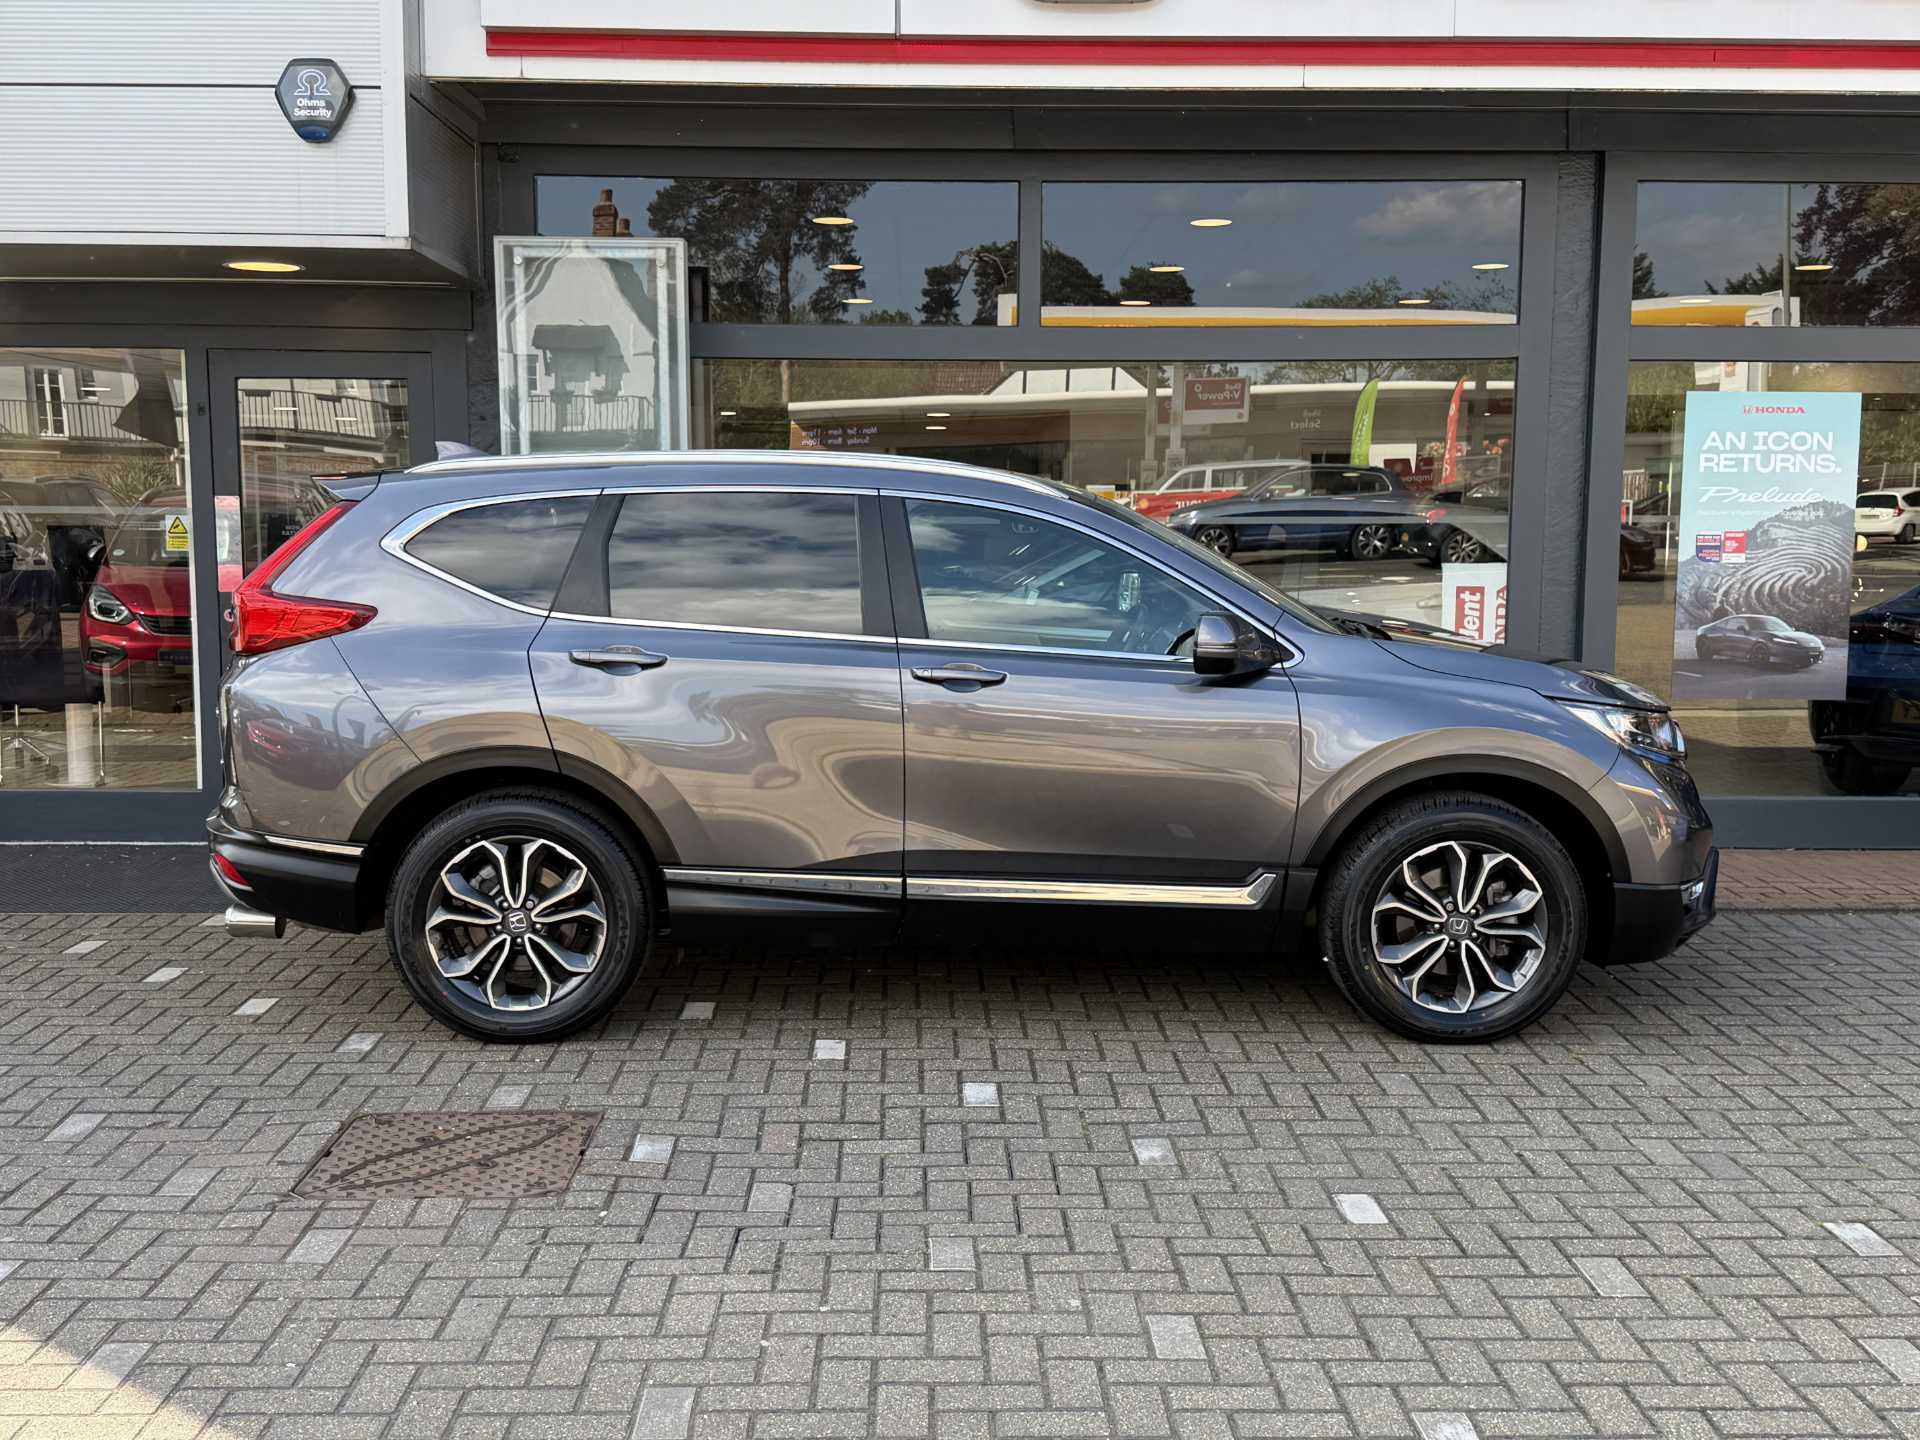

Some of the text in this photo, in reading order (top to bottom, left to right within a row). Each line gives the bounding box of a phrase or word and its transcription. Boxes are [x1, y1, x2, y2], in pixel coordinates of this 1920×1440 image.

[297, 98, 325, 107] Ohms
[293, 108, 332, 118] Security
[1755, 406, 1806, 414] HONDA
[1702, 431, 1834, 451] AN ICON
[1699, 453, 1843, 474] RETURNS.
[1698, 486, 1823, 503] Prelude
